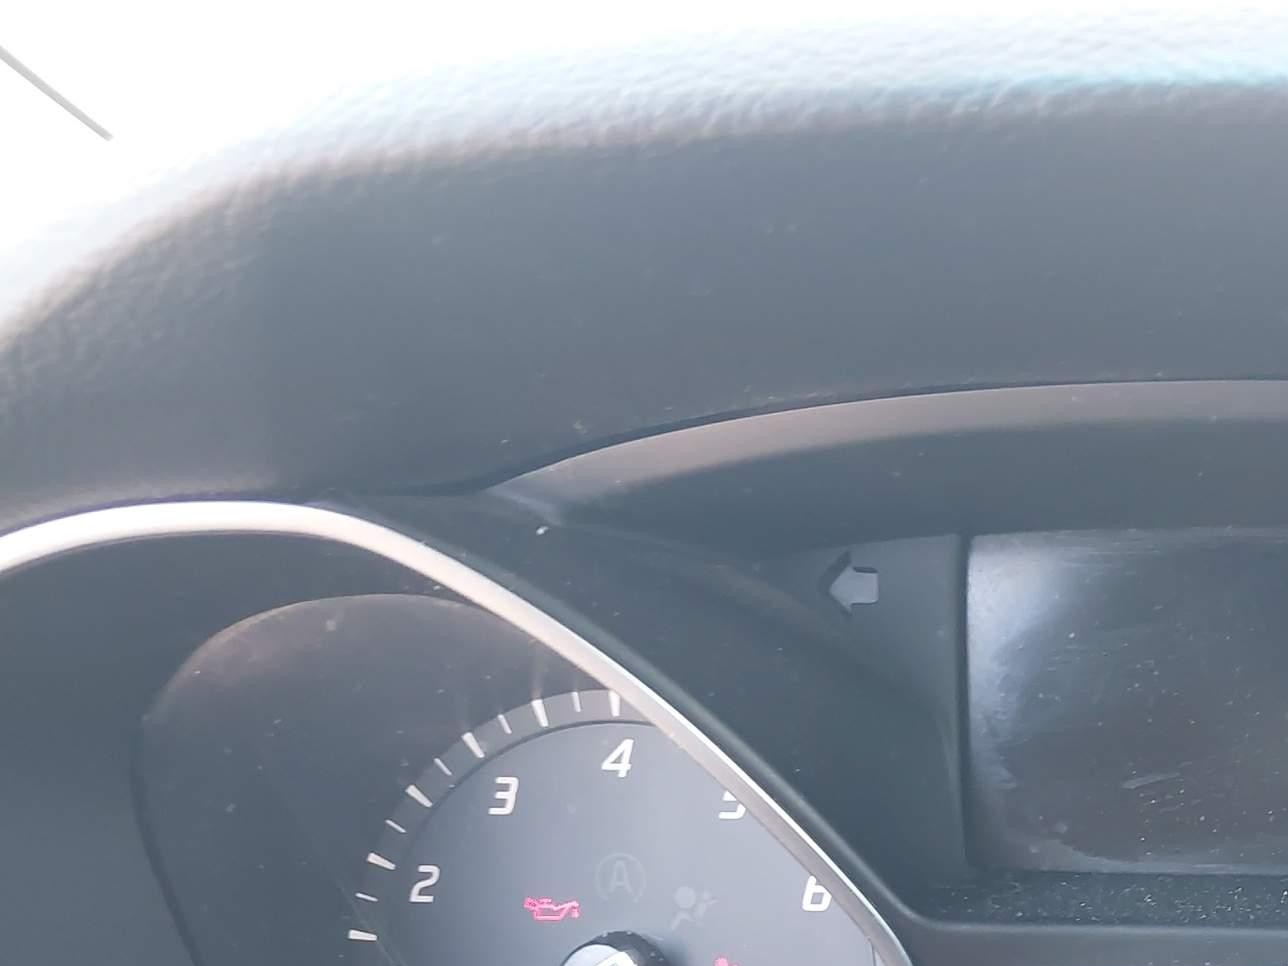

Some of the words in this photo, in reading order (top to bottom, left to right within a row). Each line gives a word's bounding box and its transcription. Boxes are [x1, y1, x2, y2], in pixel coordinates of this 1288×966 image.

[602, 739, 634, 777] 4
[489, 777, 519, 815] 3
[409, 865, 440, 902] 2
[802, 876, 833, 912] 6
